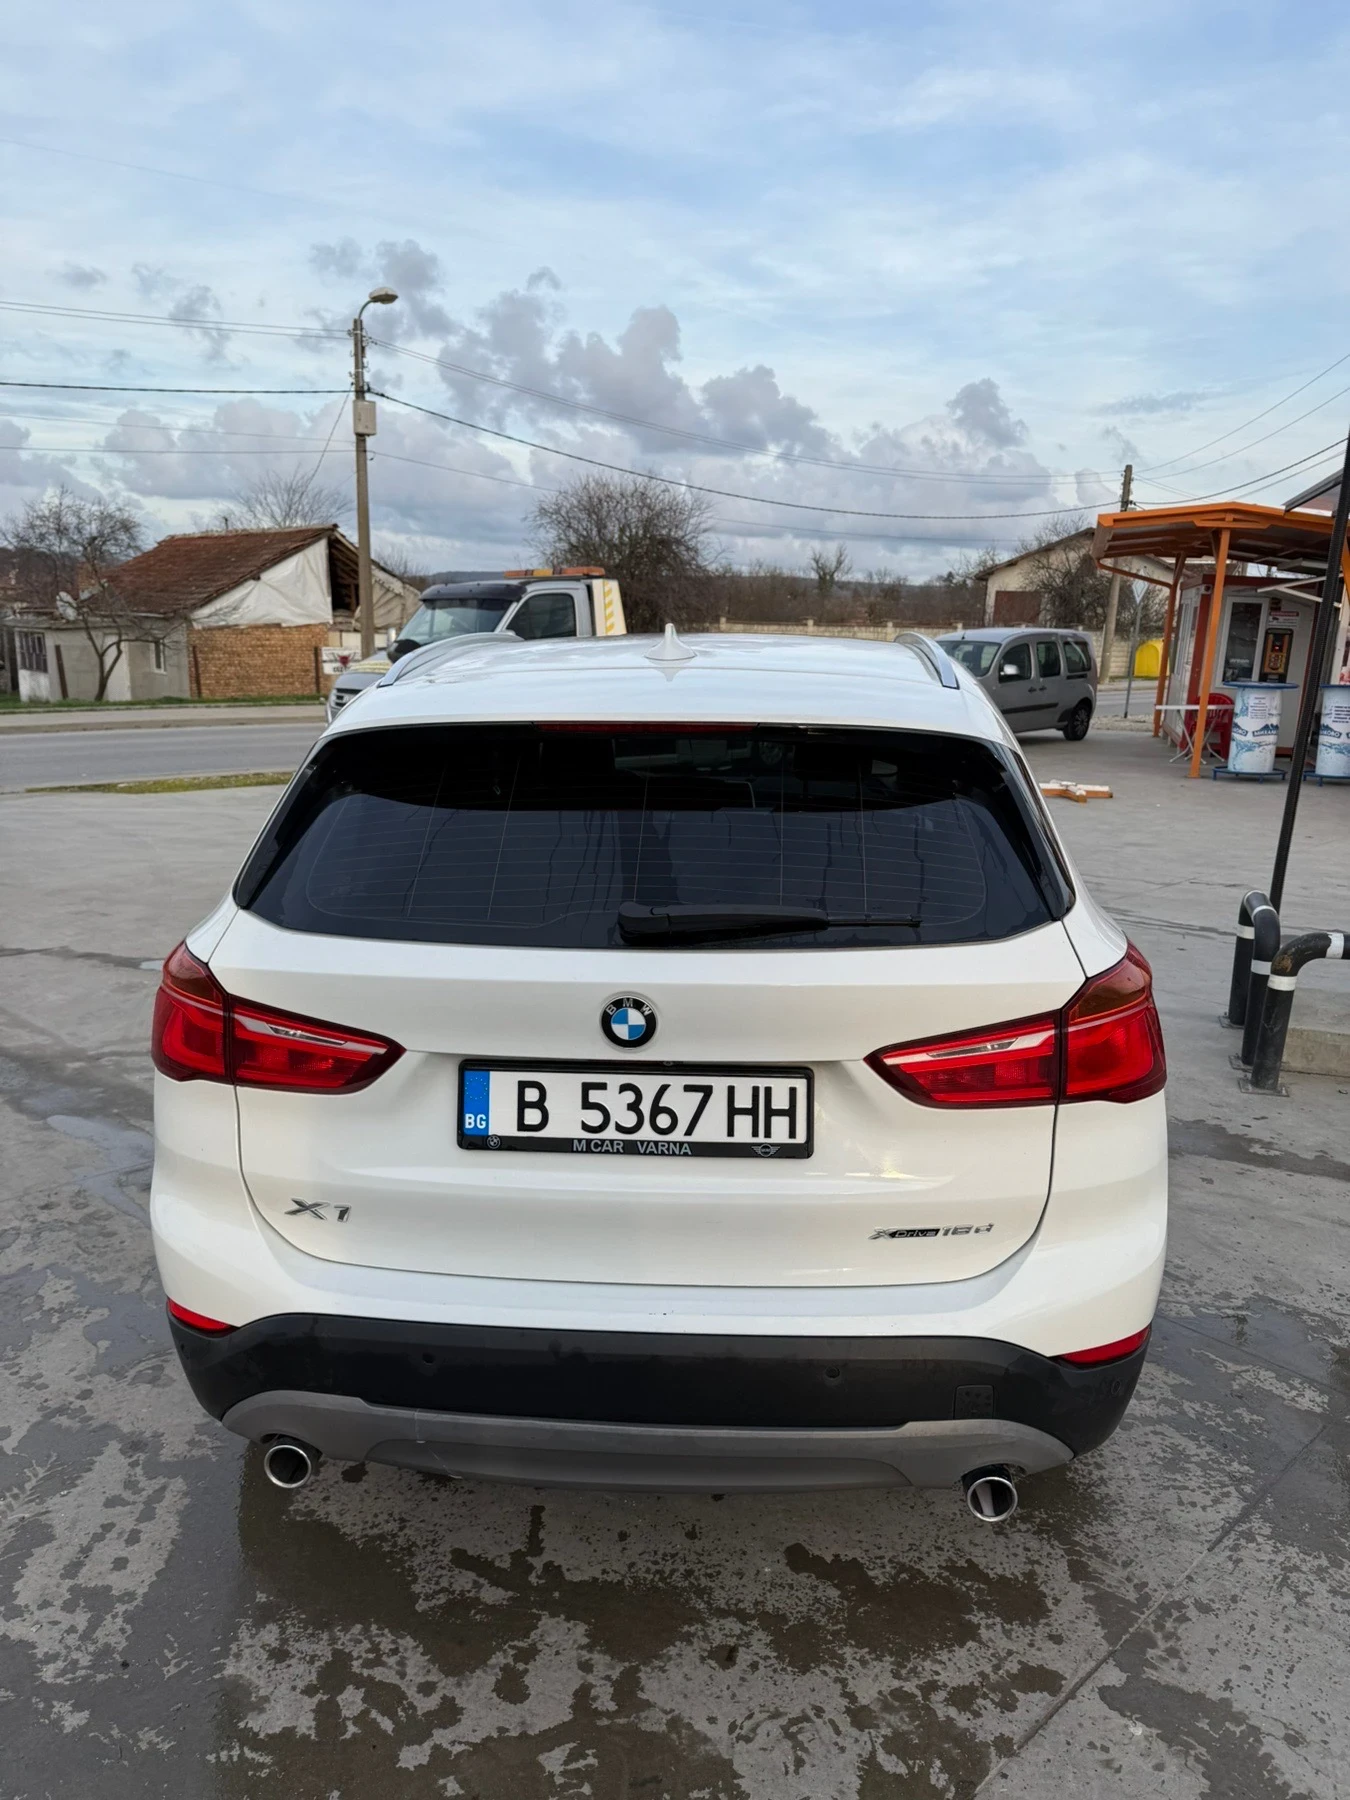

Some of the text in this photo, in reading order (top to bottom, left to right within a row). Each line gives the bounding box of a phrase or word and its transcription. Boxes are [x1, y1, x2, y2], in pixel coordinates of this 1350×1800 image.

[605, 998, 653, 1016] BMW
[517, 1080, 797, 1139] B 5367 HH
[465, 1114, 487, 1129] BG
[573, 1139, 692, 1155] M CAR VARNA
[284, 1198, 351, 1222] X1
